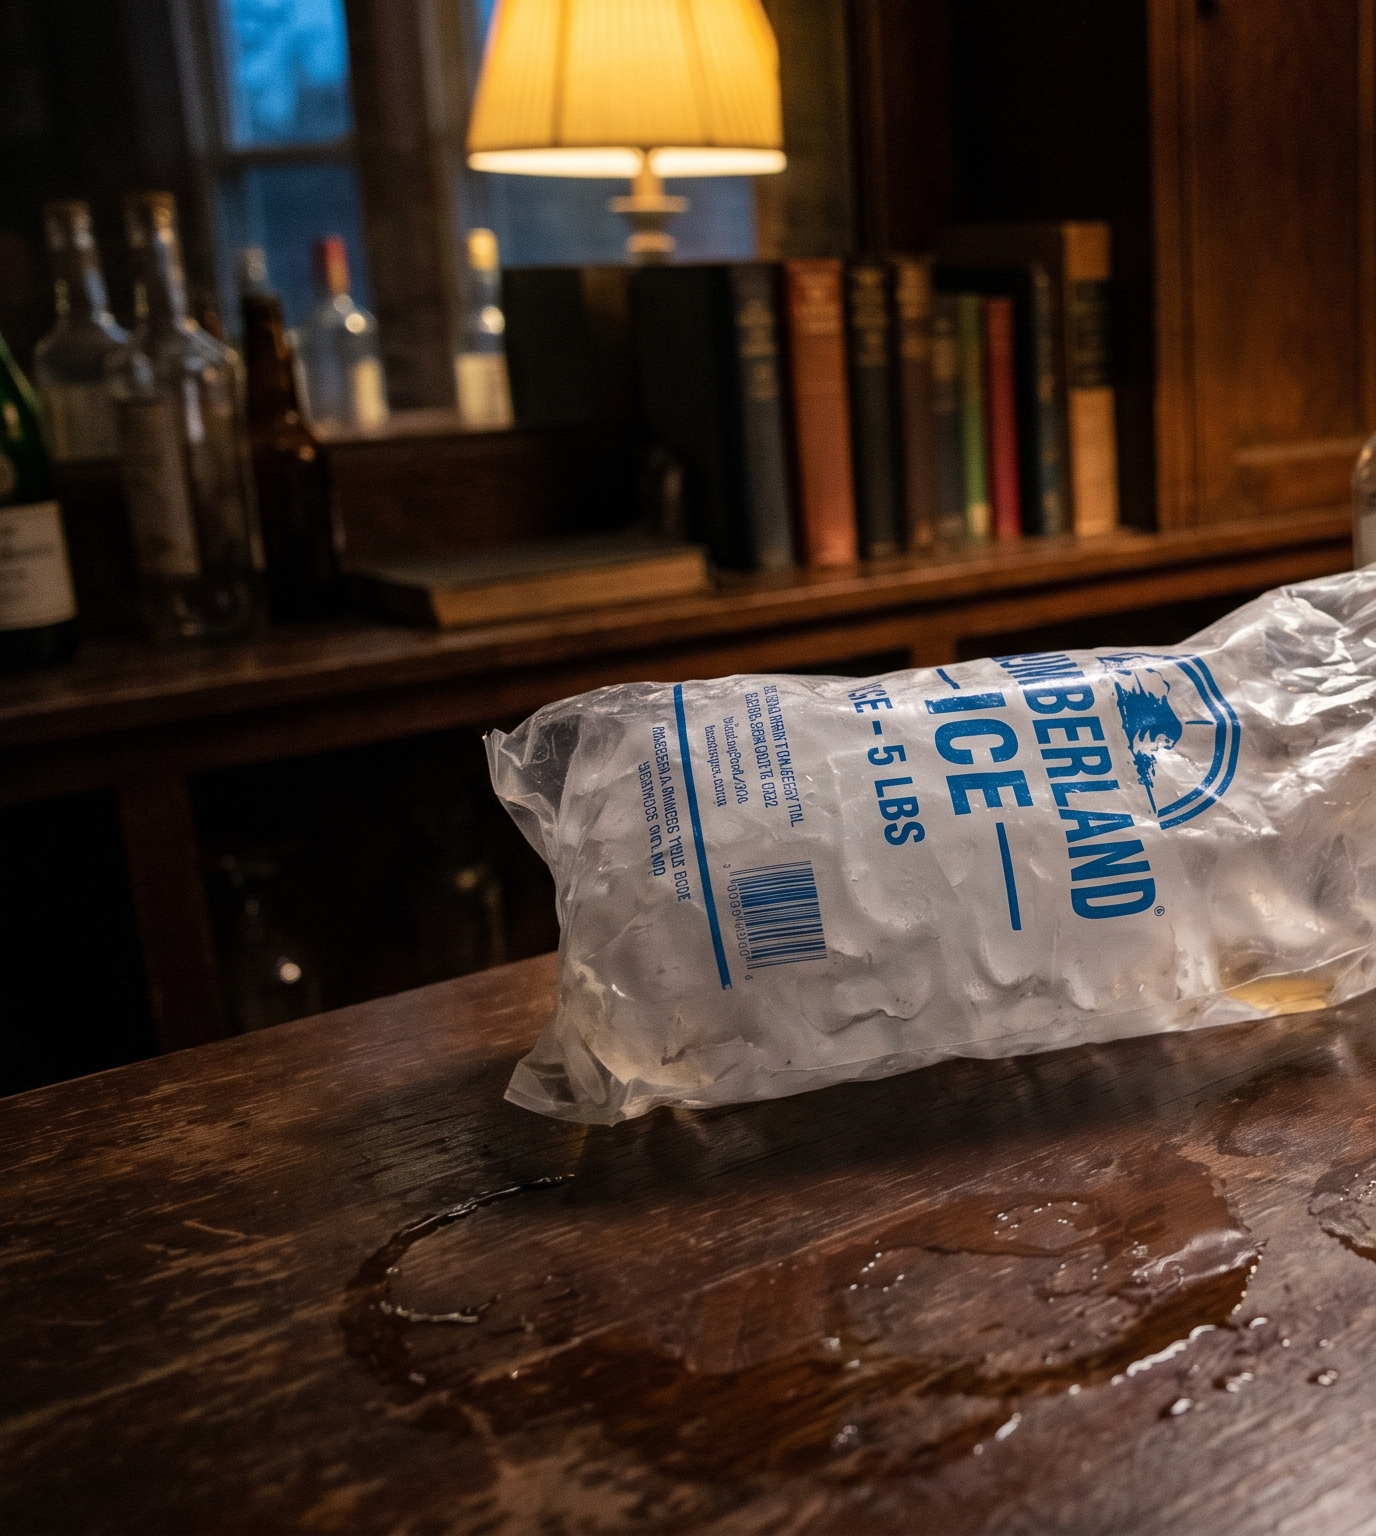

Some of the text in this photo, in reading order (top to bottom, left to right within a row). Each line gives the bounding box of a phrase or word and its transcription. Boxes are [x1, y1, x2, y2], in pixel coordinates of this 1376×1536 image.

[867, 744, 907, 766] 5
[925, 692, 1034, 816] ICE
[990, 651, 1156, 920] UMBERLAND
[874, 776, 926, 846] LBS
